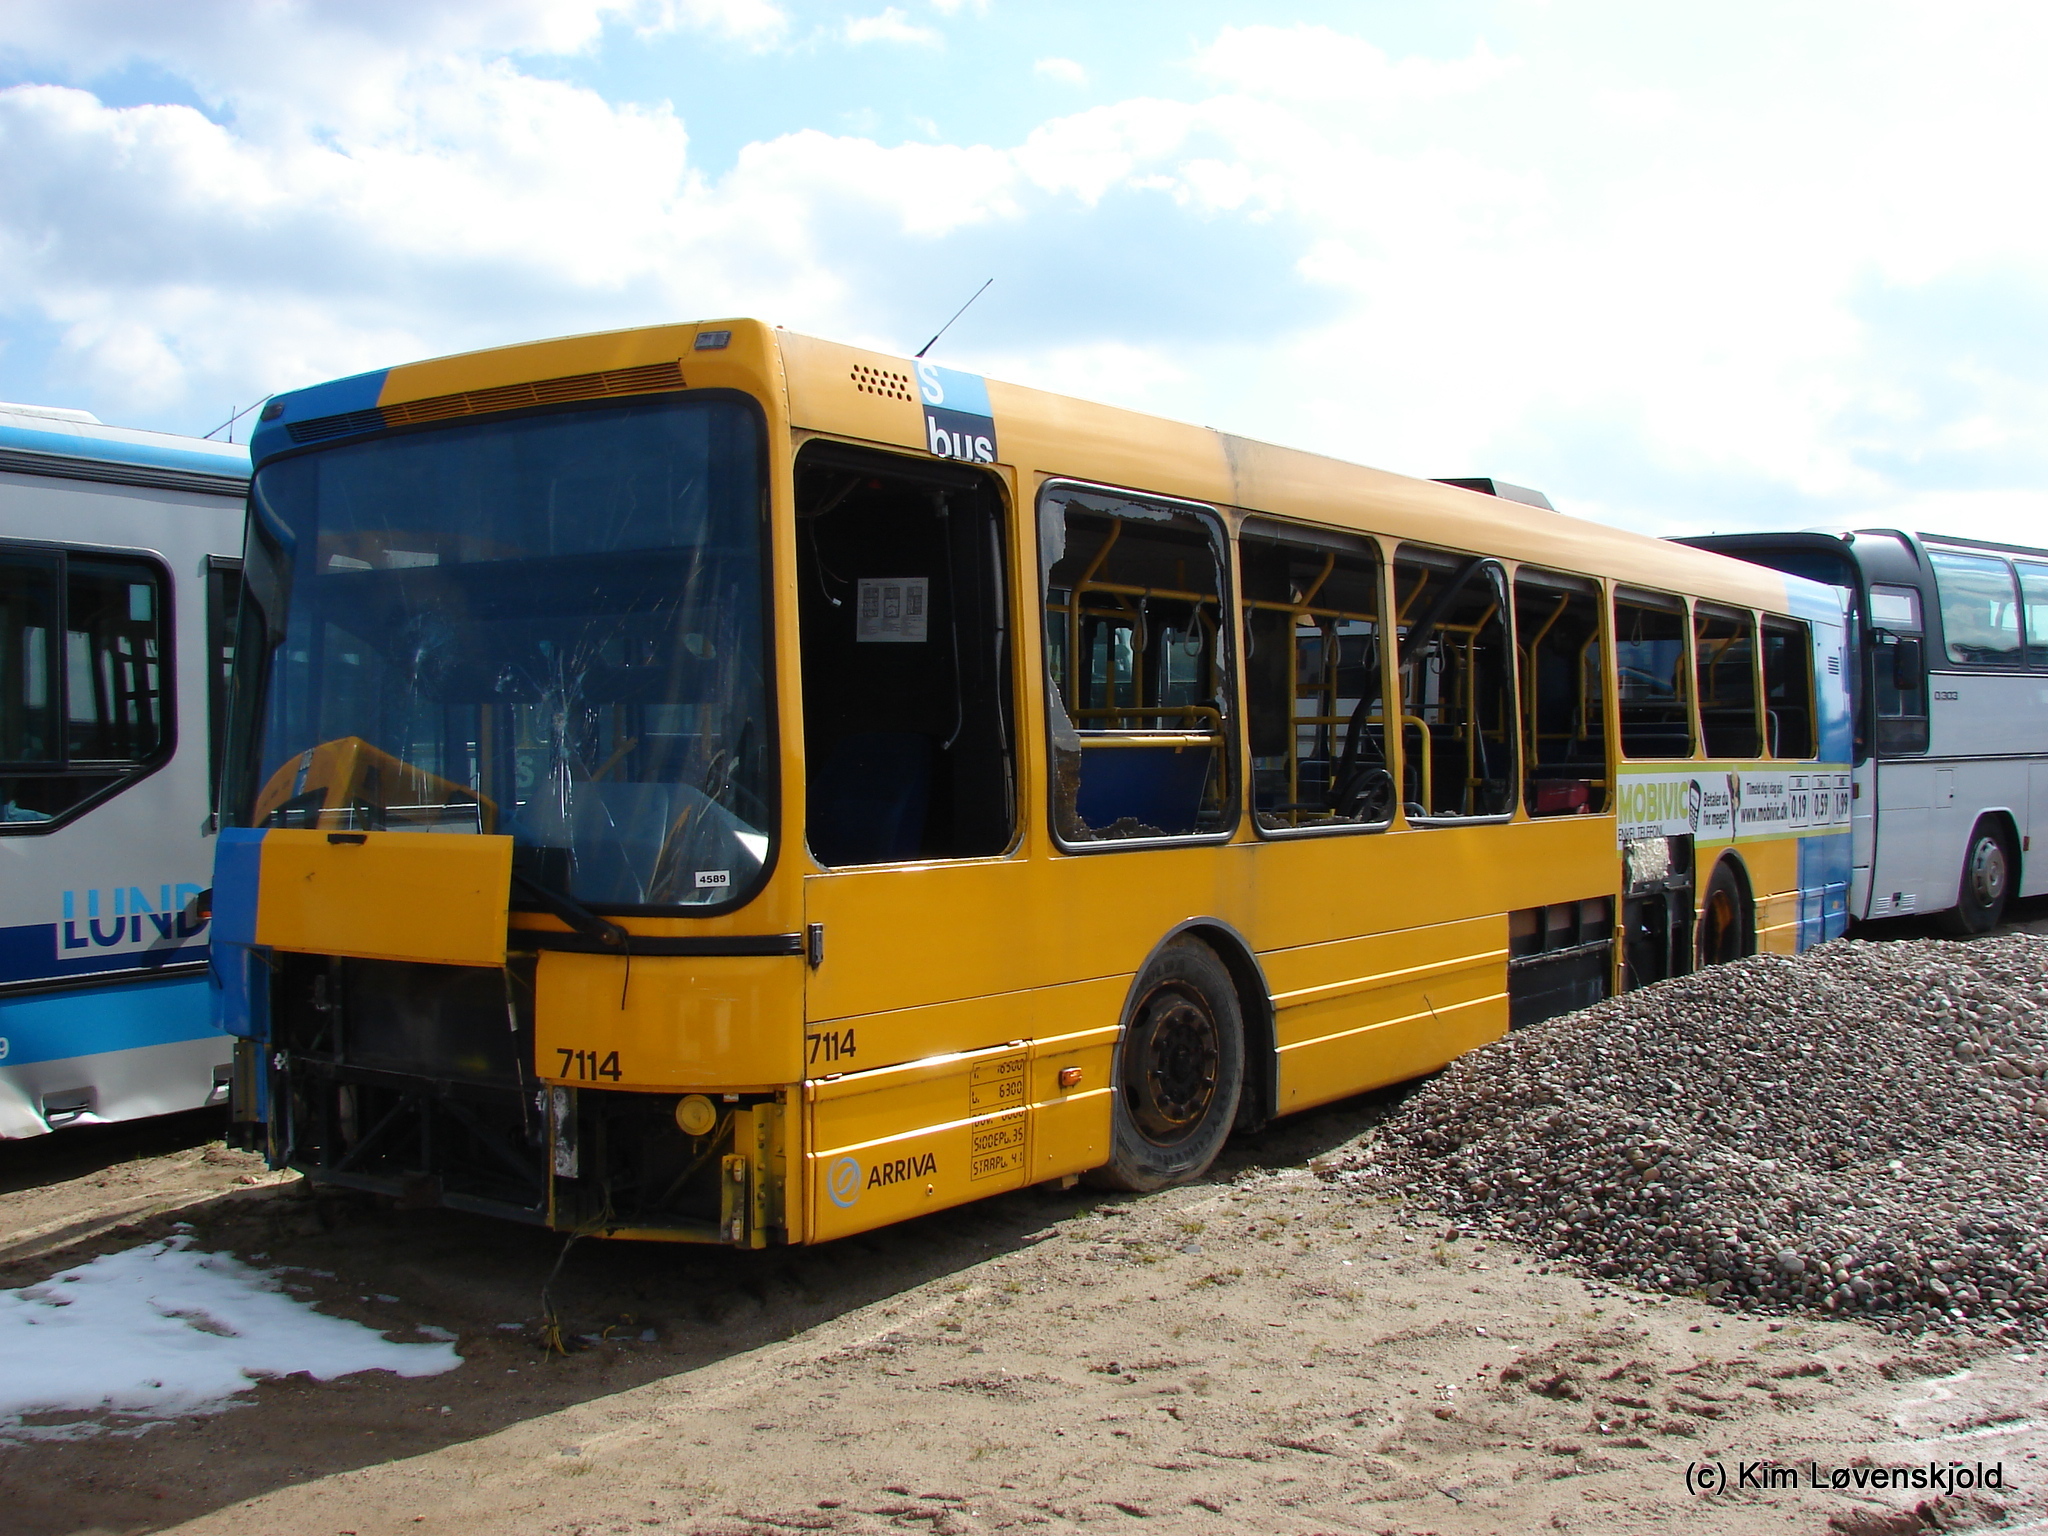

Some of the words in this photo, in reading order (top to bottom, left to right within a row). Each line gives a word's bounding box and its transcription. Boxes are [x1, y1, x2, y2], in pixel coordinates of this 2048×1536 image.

[918, 361, 944, 405] S
[928, 415, 994, 464] bus
[1618, 781, 1688, 823] MOBIVIC
[1703, 792, 1721, 807] Betaler
[1722, 791, 1729, 806] du
[1740, 802, 1788, 823] www.mobivic.dk
[1791, 794, 1807, 822] 0,19
[1814, 793, 1829, 820] 0,59
[1835, 793, 1848, 819] 1,99
[1703, 810, 1711, 826] for
[1711, 809, 1730, 829] meget?
[699, 874, 727, 884] 4589
[62, 883, 210, 950] LUND
[806, 1028, 857, 1065] 7114
[556, 1048, 623, 1082] 7114
[999, 1080, 1023, 1098] 6300
[866, 1152, 938, 1190] ARRIVA
